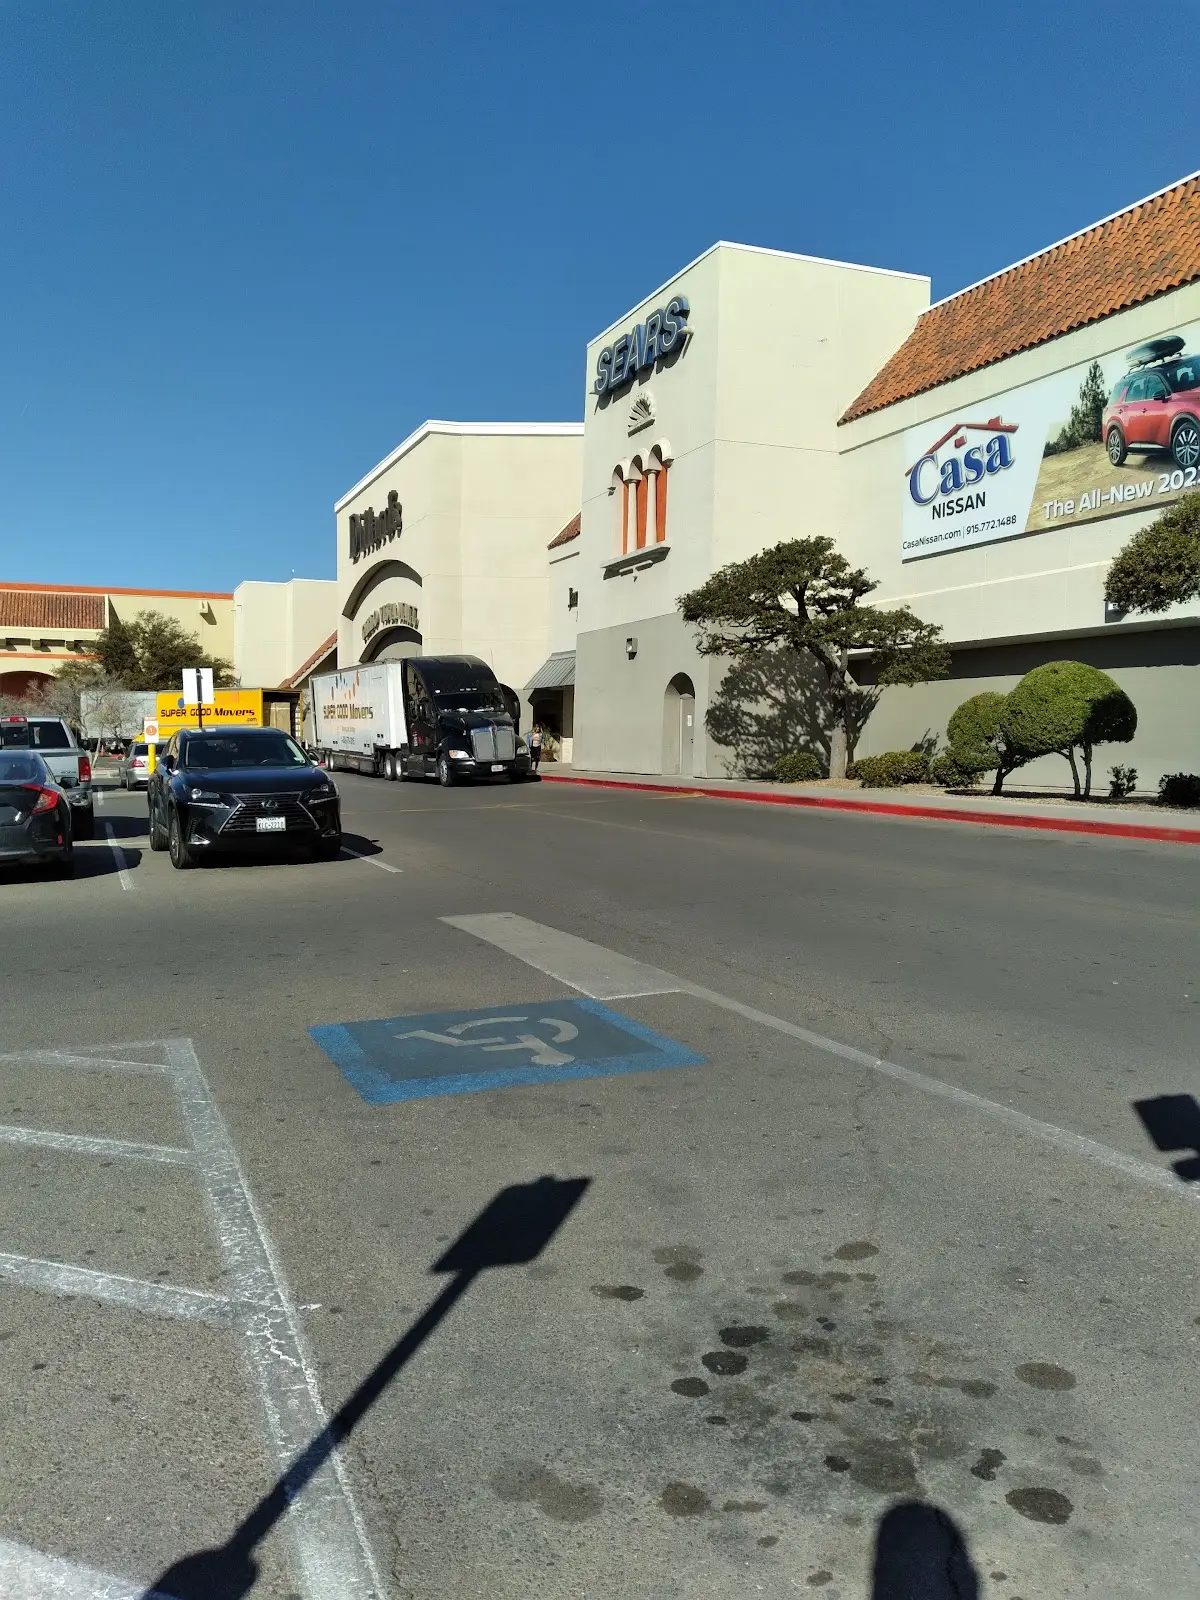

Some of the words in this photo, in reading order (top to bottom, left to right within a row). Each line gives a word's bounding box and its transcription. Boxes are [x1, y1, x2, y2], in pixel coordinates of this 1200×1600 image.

[594, 295, 690, 396] SEARS
[908, 433, 1015, 506] Casa
[931, 491, 987, 520] NISSAN
[1043, 498, 1075, 520] The
[1079, 480, 1155, 513] All-New
[1158, 465, 1200, 494] 202
[902, 529, 962, 550] CasaNissan.com
[966, 514, 1017, 535] 915.772.1488
[160, 708, 187, 718] SUPER
[190, 708, 212, 717] GOOD
[214, 707, 255, 717] Movers
[349, 703, 374, 720] Movers
